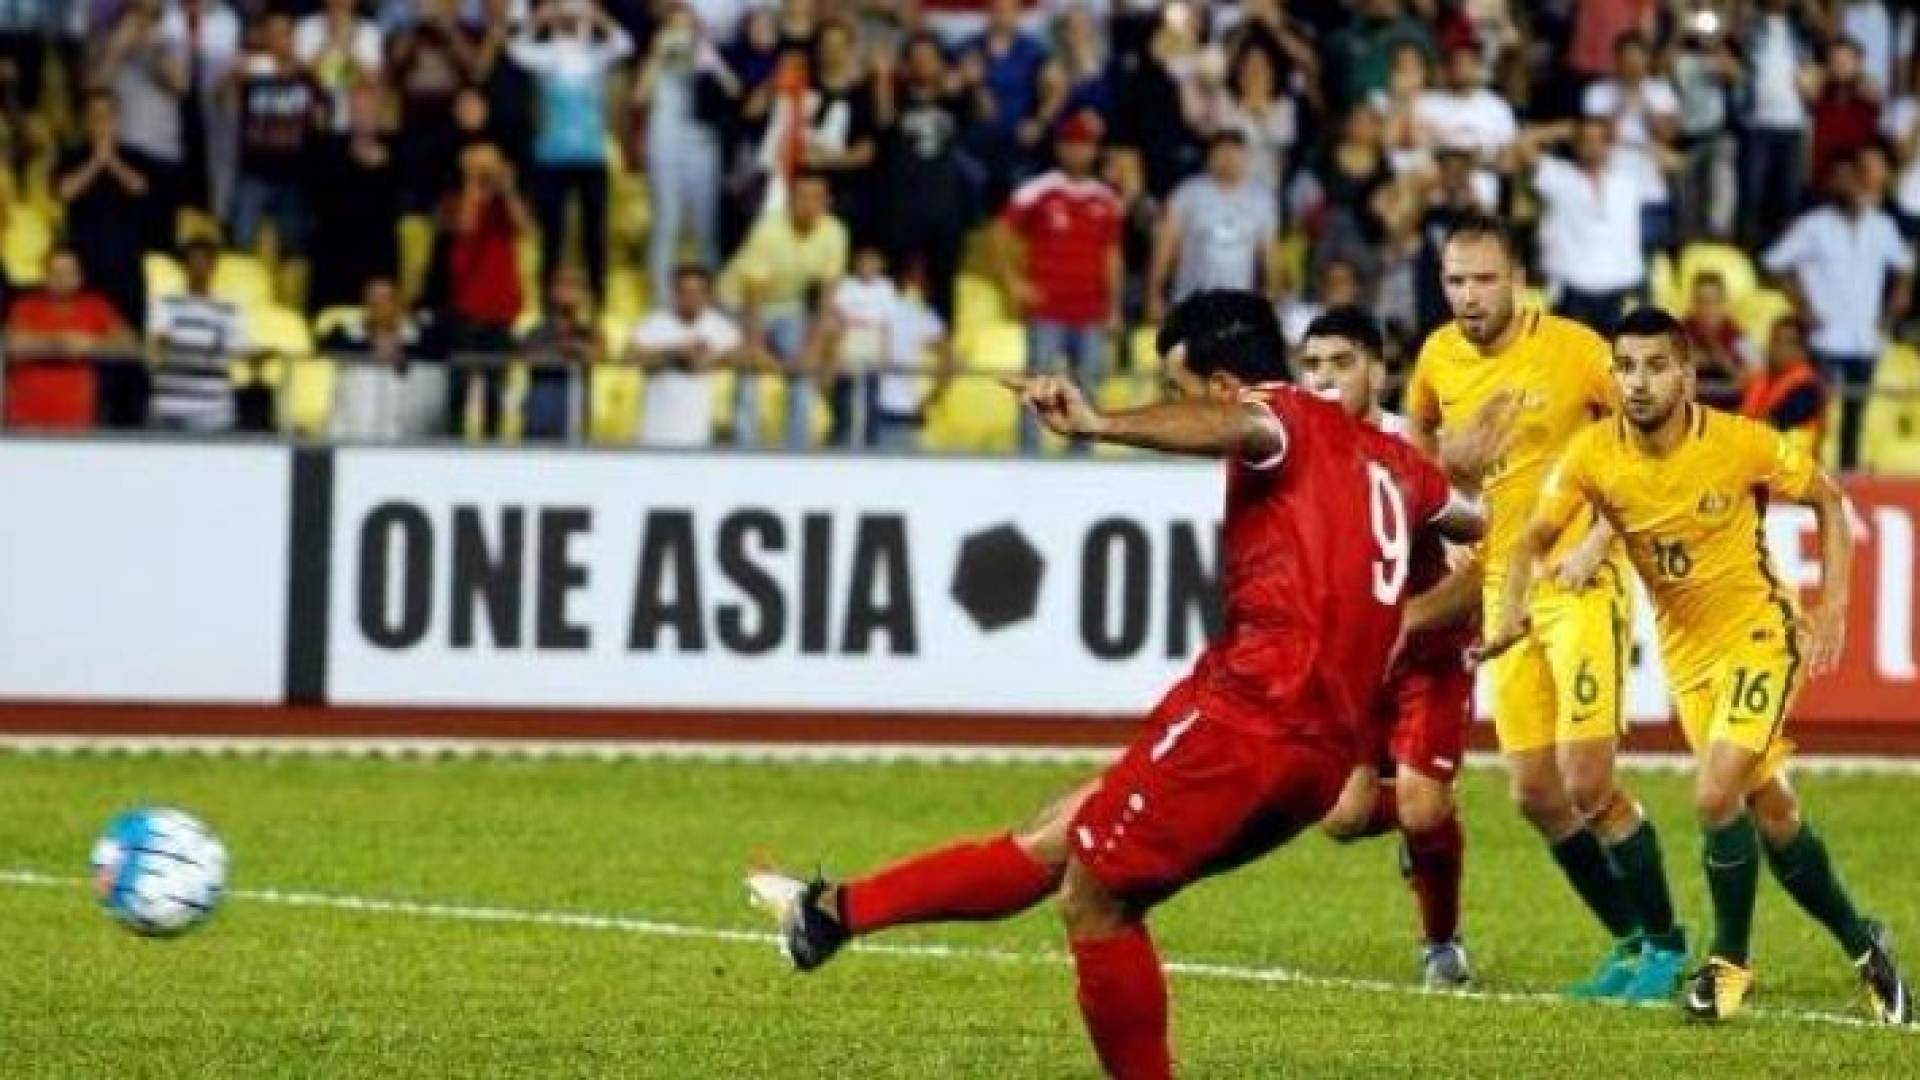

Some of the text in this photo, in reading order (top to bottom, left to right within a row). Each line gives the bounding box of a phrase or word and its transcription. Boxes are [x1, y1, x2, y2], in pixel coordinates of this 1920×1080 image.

[1368, 461, 1410, 605] 9
[357, 499, 593, 650] ONE
[628, 505, 919, 656] ASIA
[1654, 537, 1692, 578] 16
[1573, 659, 1598, 704] 6
[1731, 667, 1771, 712] 16
